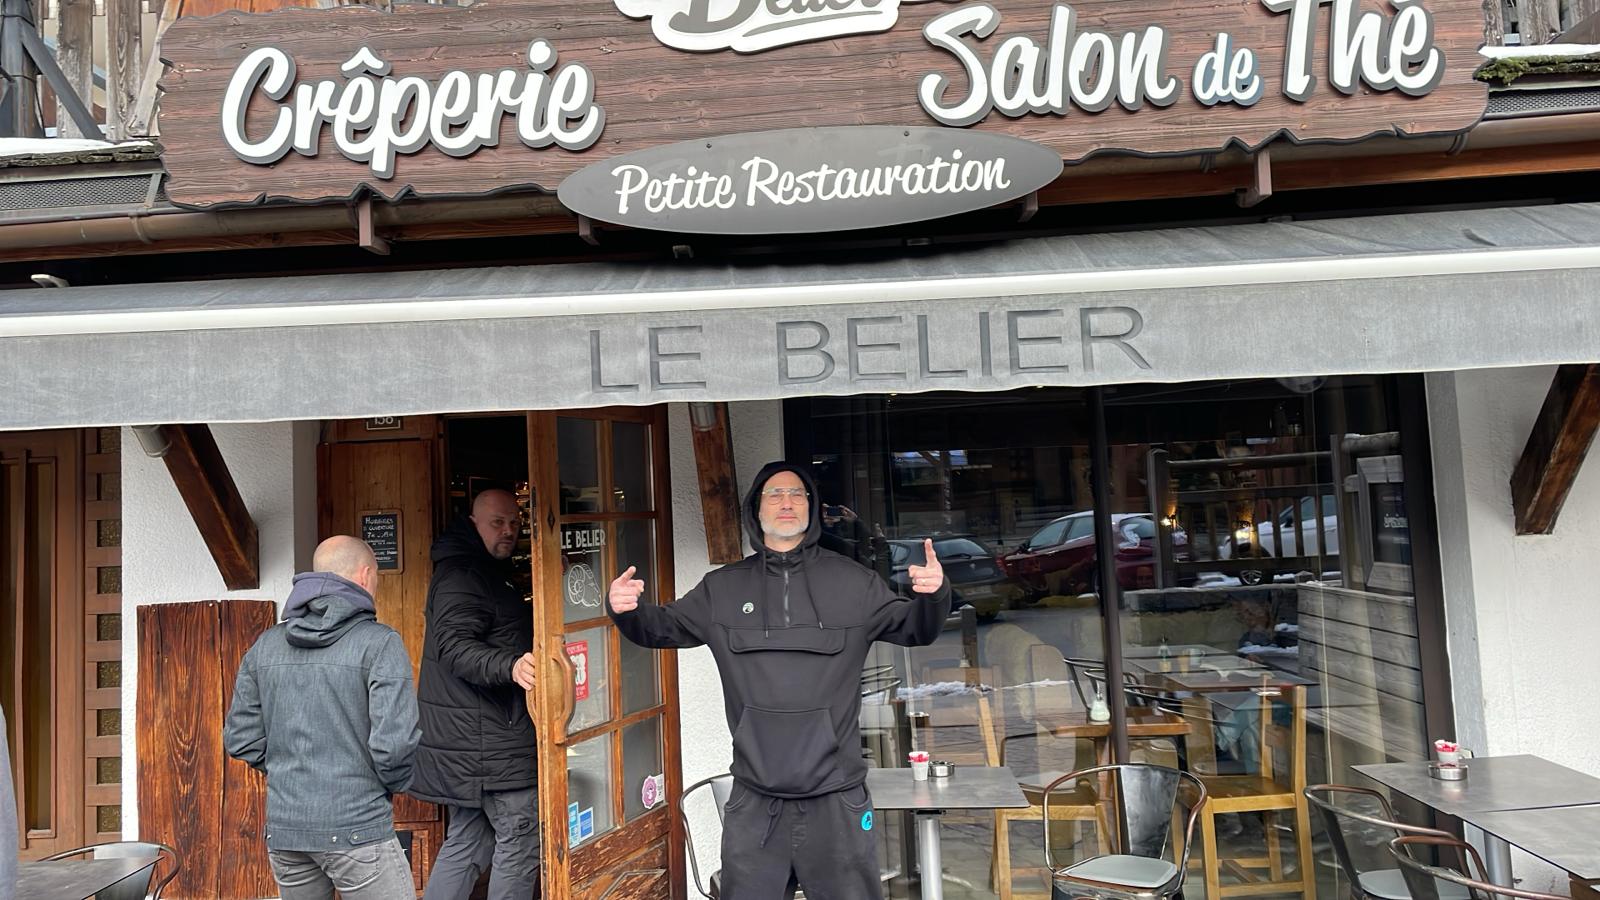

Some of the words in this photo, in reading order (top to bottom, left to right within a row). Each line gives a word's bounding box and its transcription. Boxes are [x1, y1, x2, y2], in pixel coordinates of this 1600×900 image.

[918, 3, 1183, 127] Salon
[1192, 32, 1264, 107] de
[222, 38, 606, 180] Crêperie
[612, 164, 736, 215] Petite
[742, 149, 1010, 206] Restauration
[589, 325, 707, 393] LE
[775, 306, 1153, 386] BELIER
[560, 530, 573, 550] LE
[575, 528, 606, 549] BELIER
